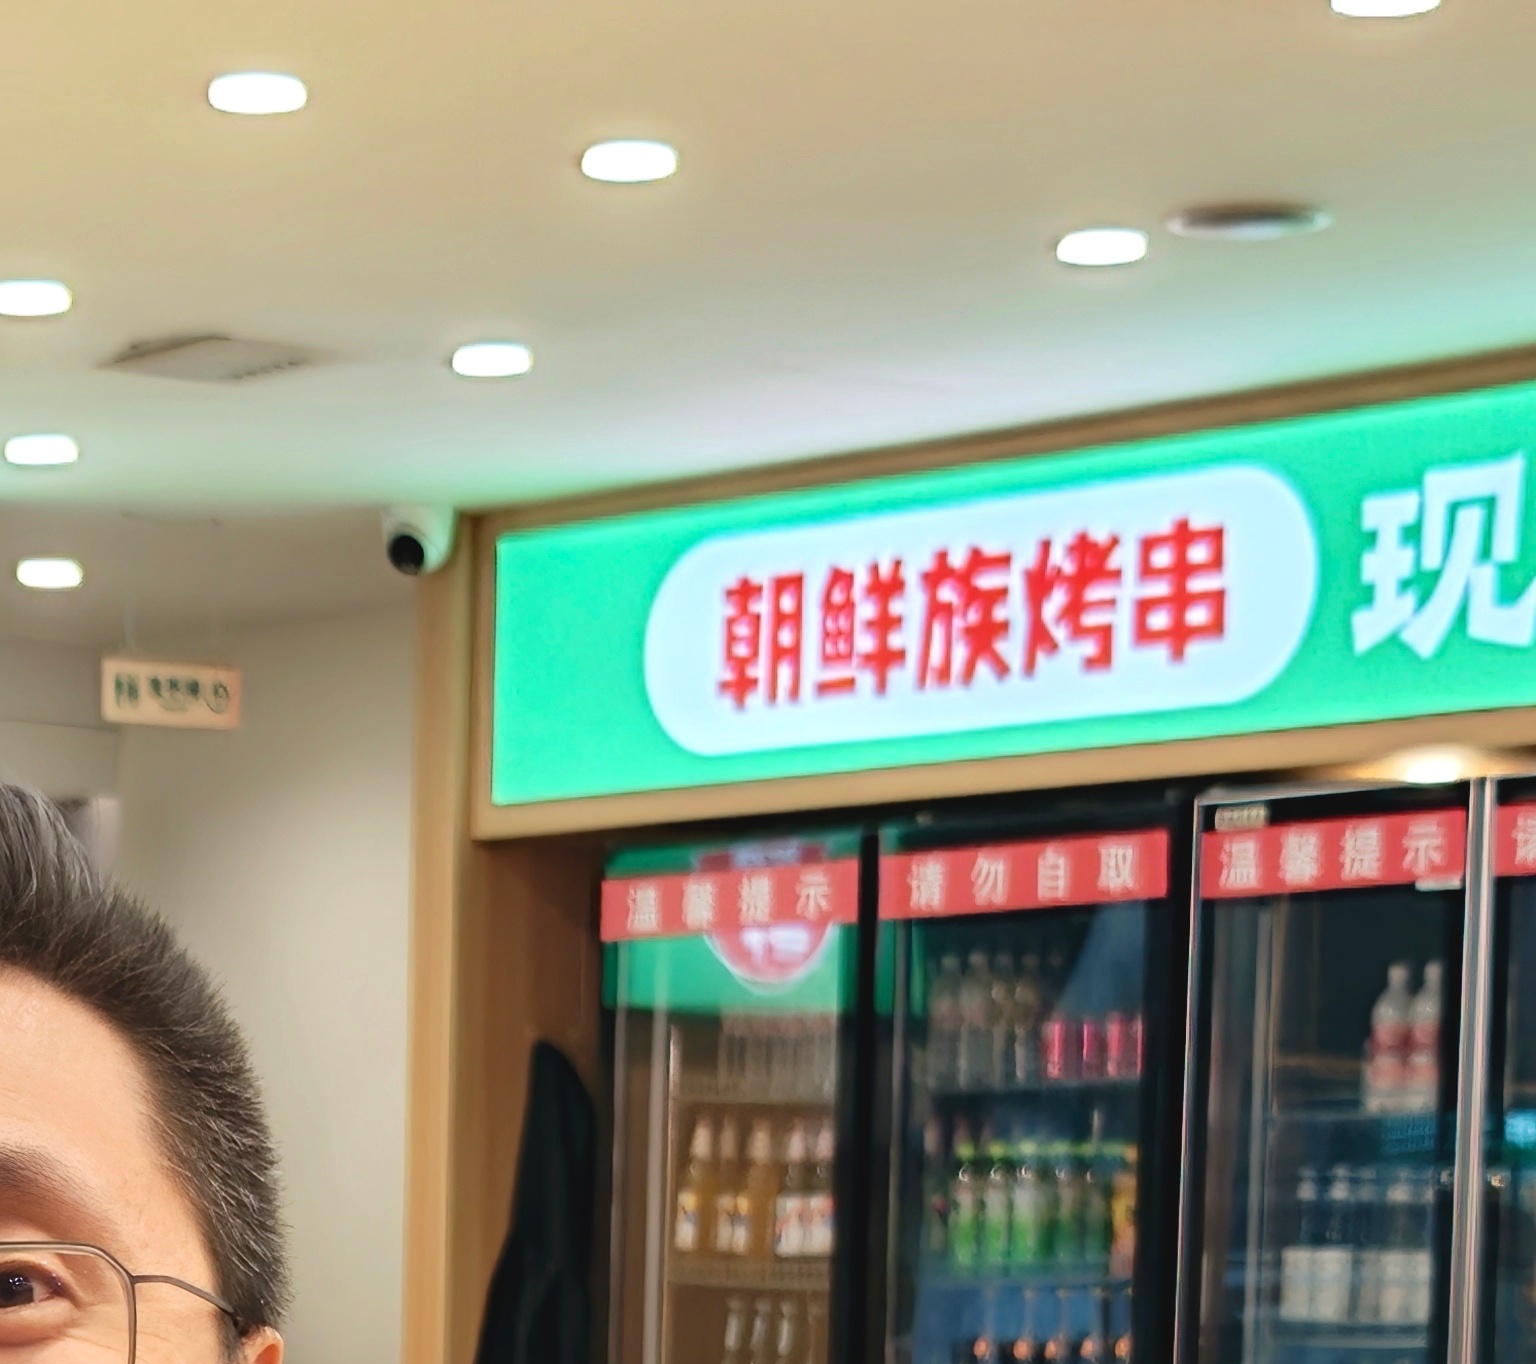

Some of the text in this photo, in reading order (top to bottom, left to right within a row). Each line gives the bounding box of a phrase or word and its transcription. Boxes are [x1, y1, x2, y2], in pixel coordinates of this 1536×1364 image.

[719, 518, 1225, 709] 朝鲜族烤串
[1351, 450, 1536, 659] 现
[908, 836, 1138, 910] 请勿自取
